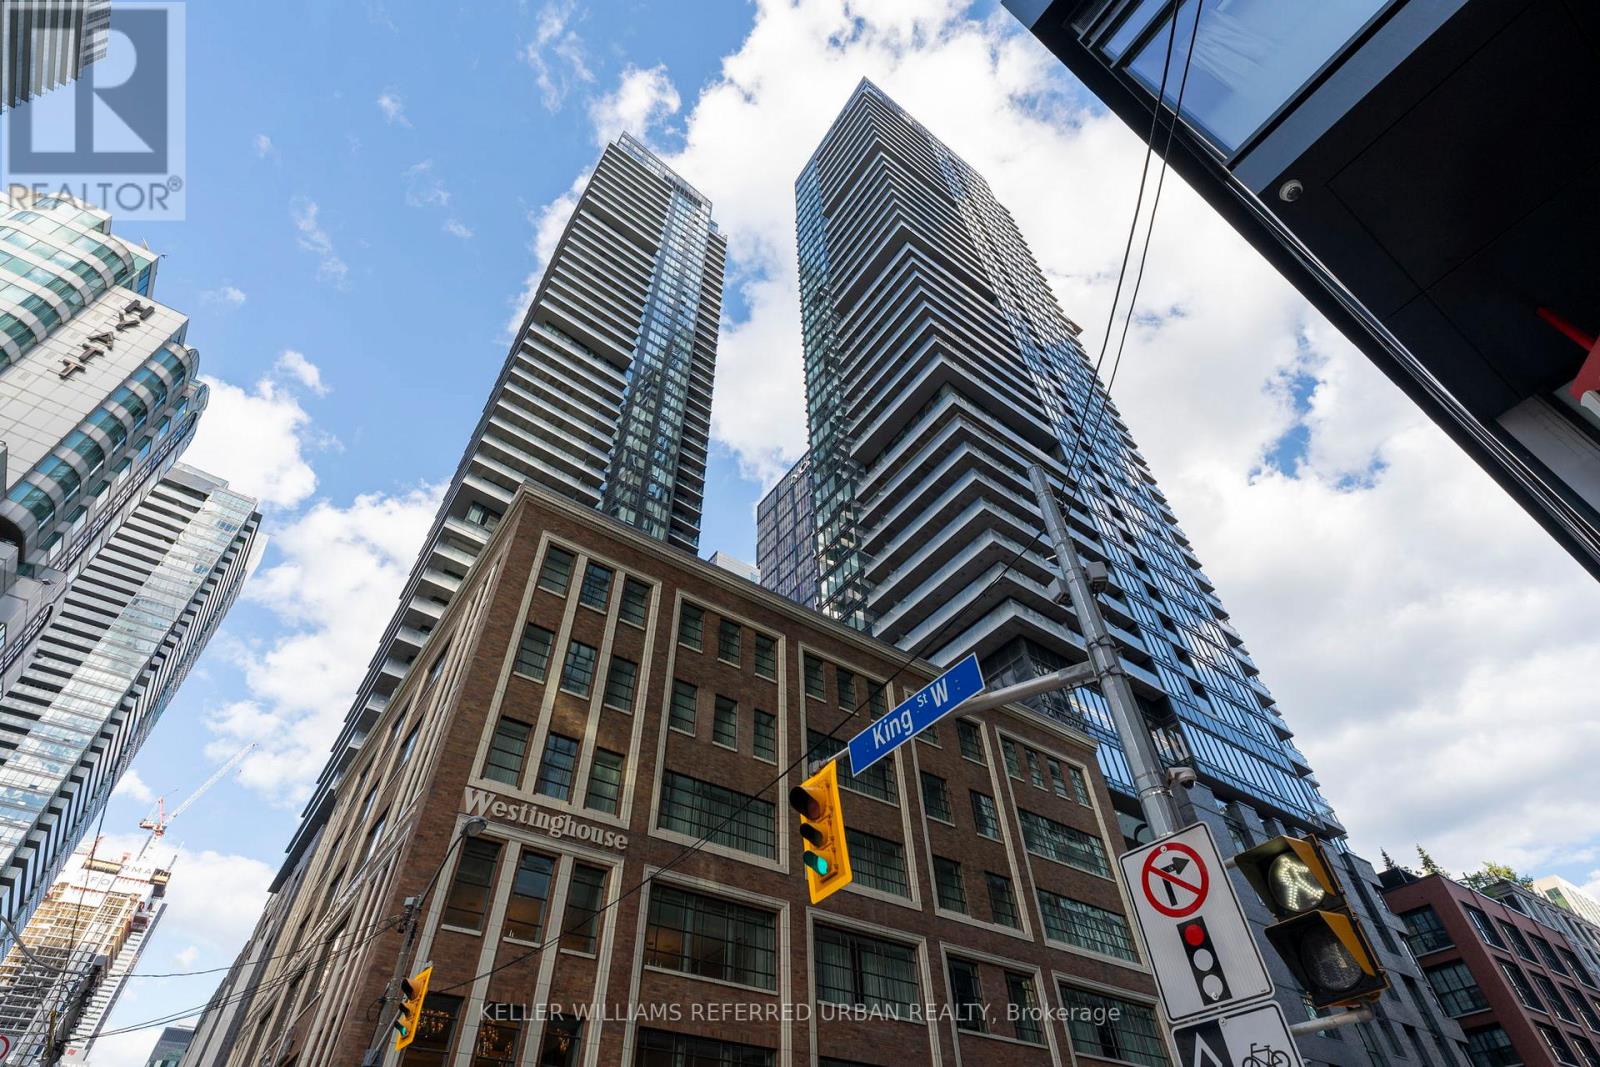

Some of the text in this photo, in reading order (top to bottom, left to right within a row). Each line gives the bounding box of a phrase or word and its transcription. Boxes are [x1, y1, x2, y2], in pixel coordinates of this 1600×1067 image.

[60, 299, 155, 380] HYATT
[872, 678, 949, 750] King St W
[464, 786, 629, 850] Westinghouse
